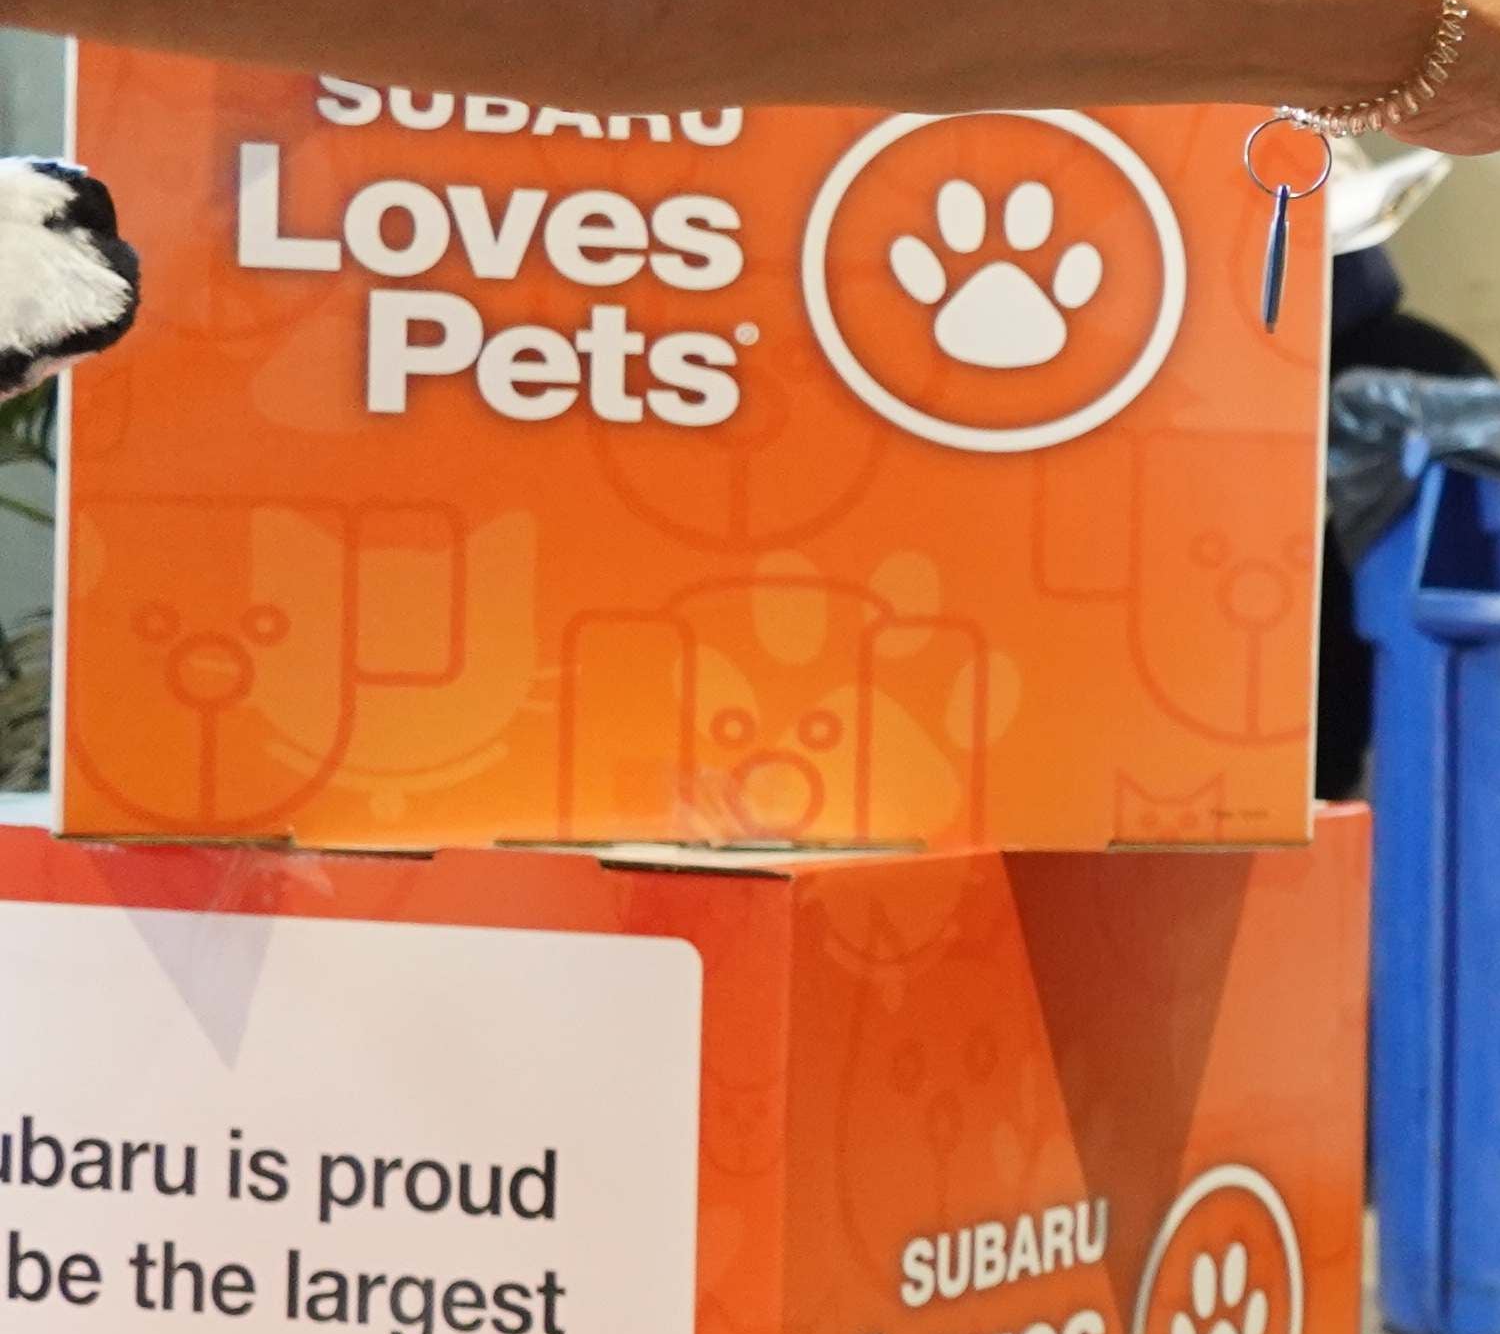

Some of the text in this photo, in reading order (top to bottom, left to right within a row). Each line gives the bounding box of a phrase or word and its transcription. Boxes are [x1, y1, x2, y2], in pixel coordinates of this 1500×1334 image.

[236, 141, 746, 292] Loves
[226, 1128, 291, 1205] is
[319, 1149, 560, 1223] proud
[7, 1229, 104, 1309] be
[130, 1239, 257, 1318] the
[900, 1197, 1108, 1308] SUBARU
